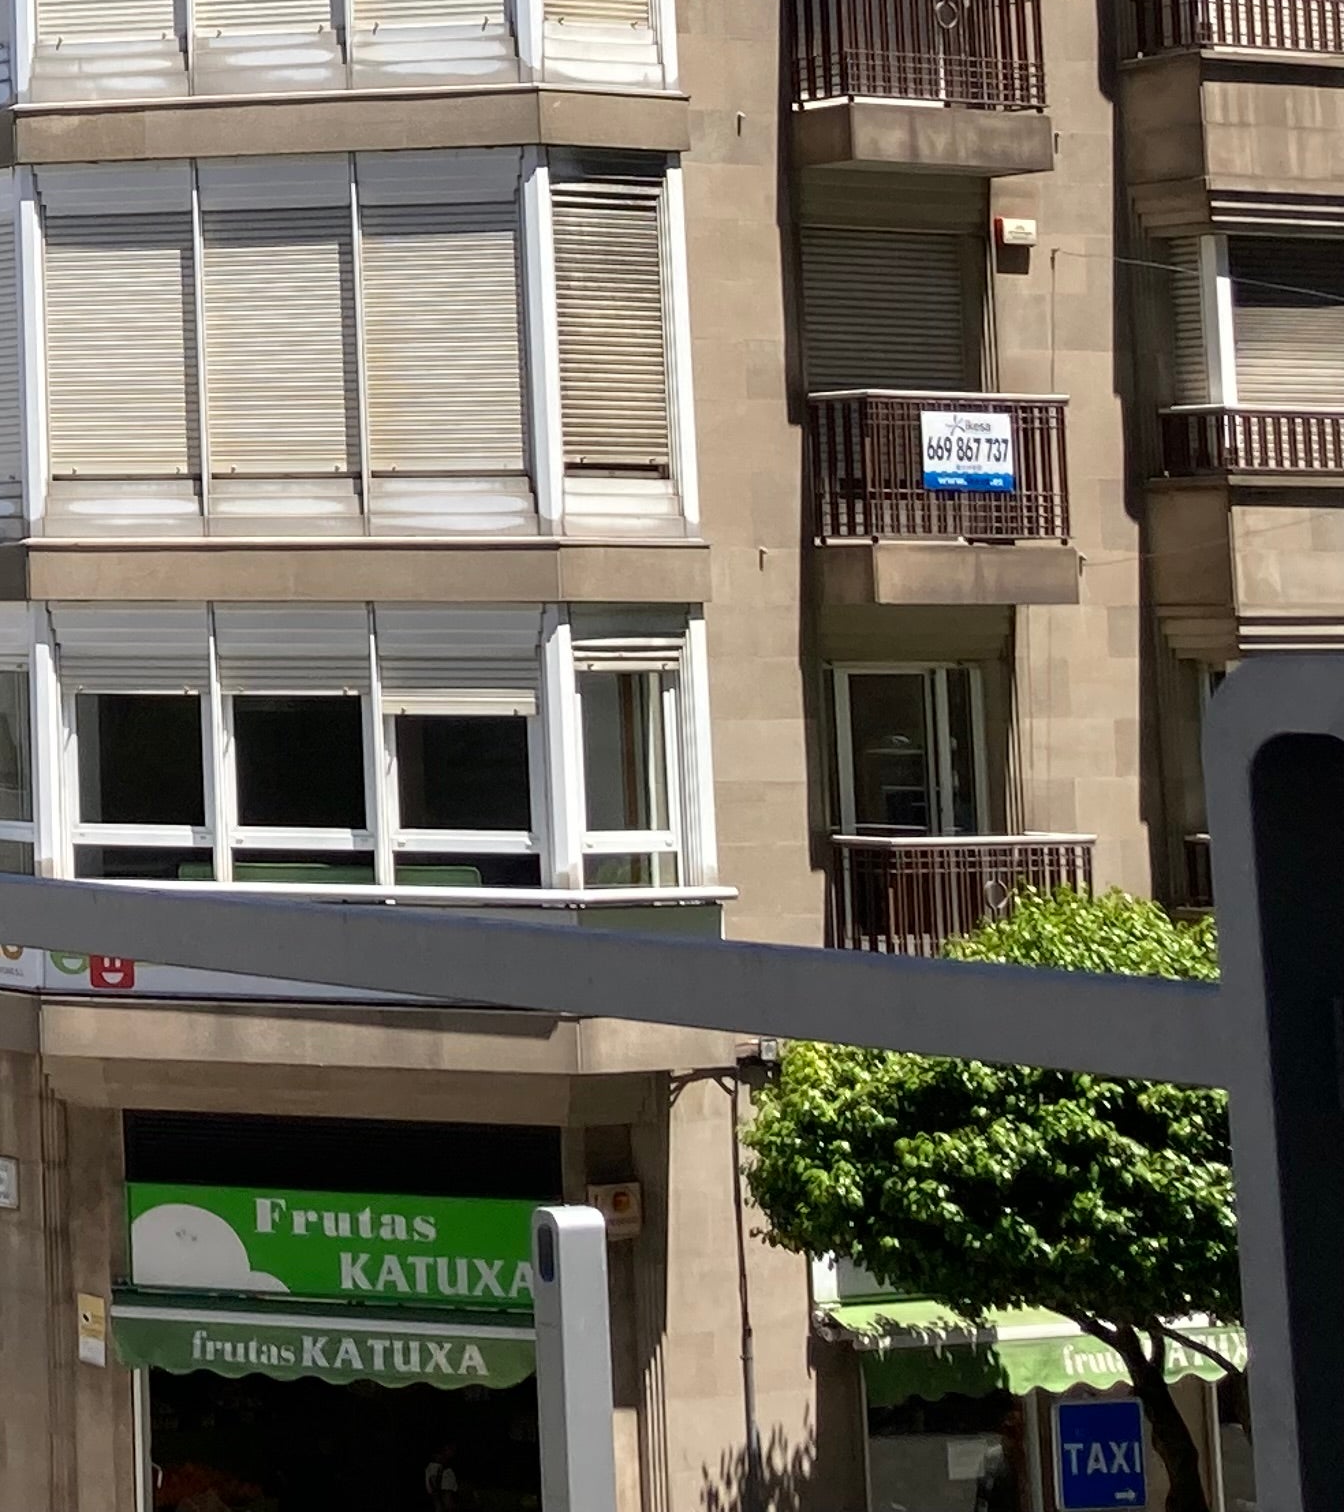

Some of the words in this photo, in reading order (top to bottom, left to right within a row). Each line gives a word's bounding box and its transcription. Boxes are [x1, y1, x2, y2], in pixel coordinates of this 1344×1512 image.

[927, 436, 952, 461] 669
[956, 436, 981, 462] 867
[985, 437, 1009, 463] 737
[254, 1198, 437, 1242] Frutas
[339, 1252, 535, 1298] KATUXA
[191, 1329, 296, 1367] frutas
[301, 1335, 490, 1376] KATUXA
[1063, 1441, 1141, 1476] TAXI
